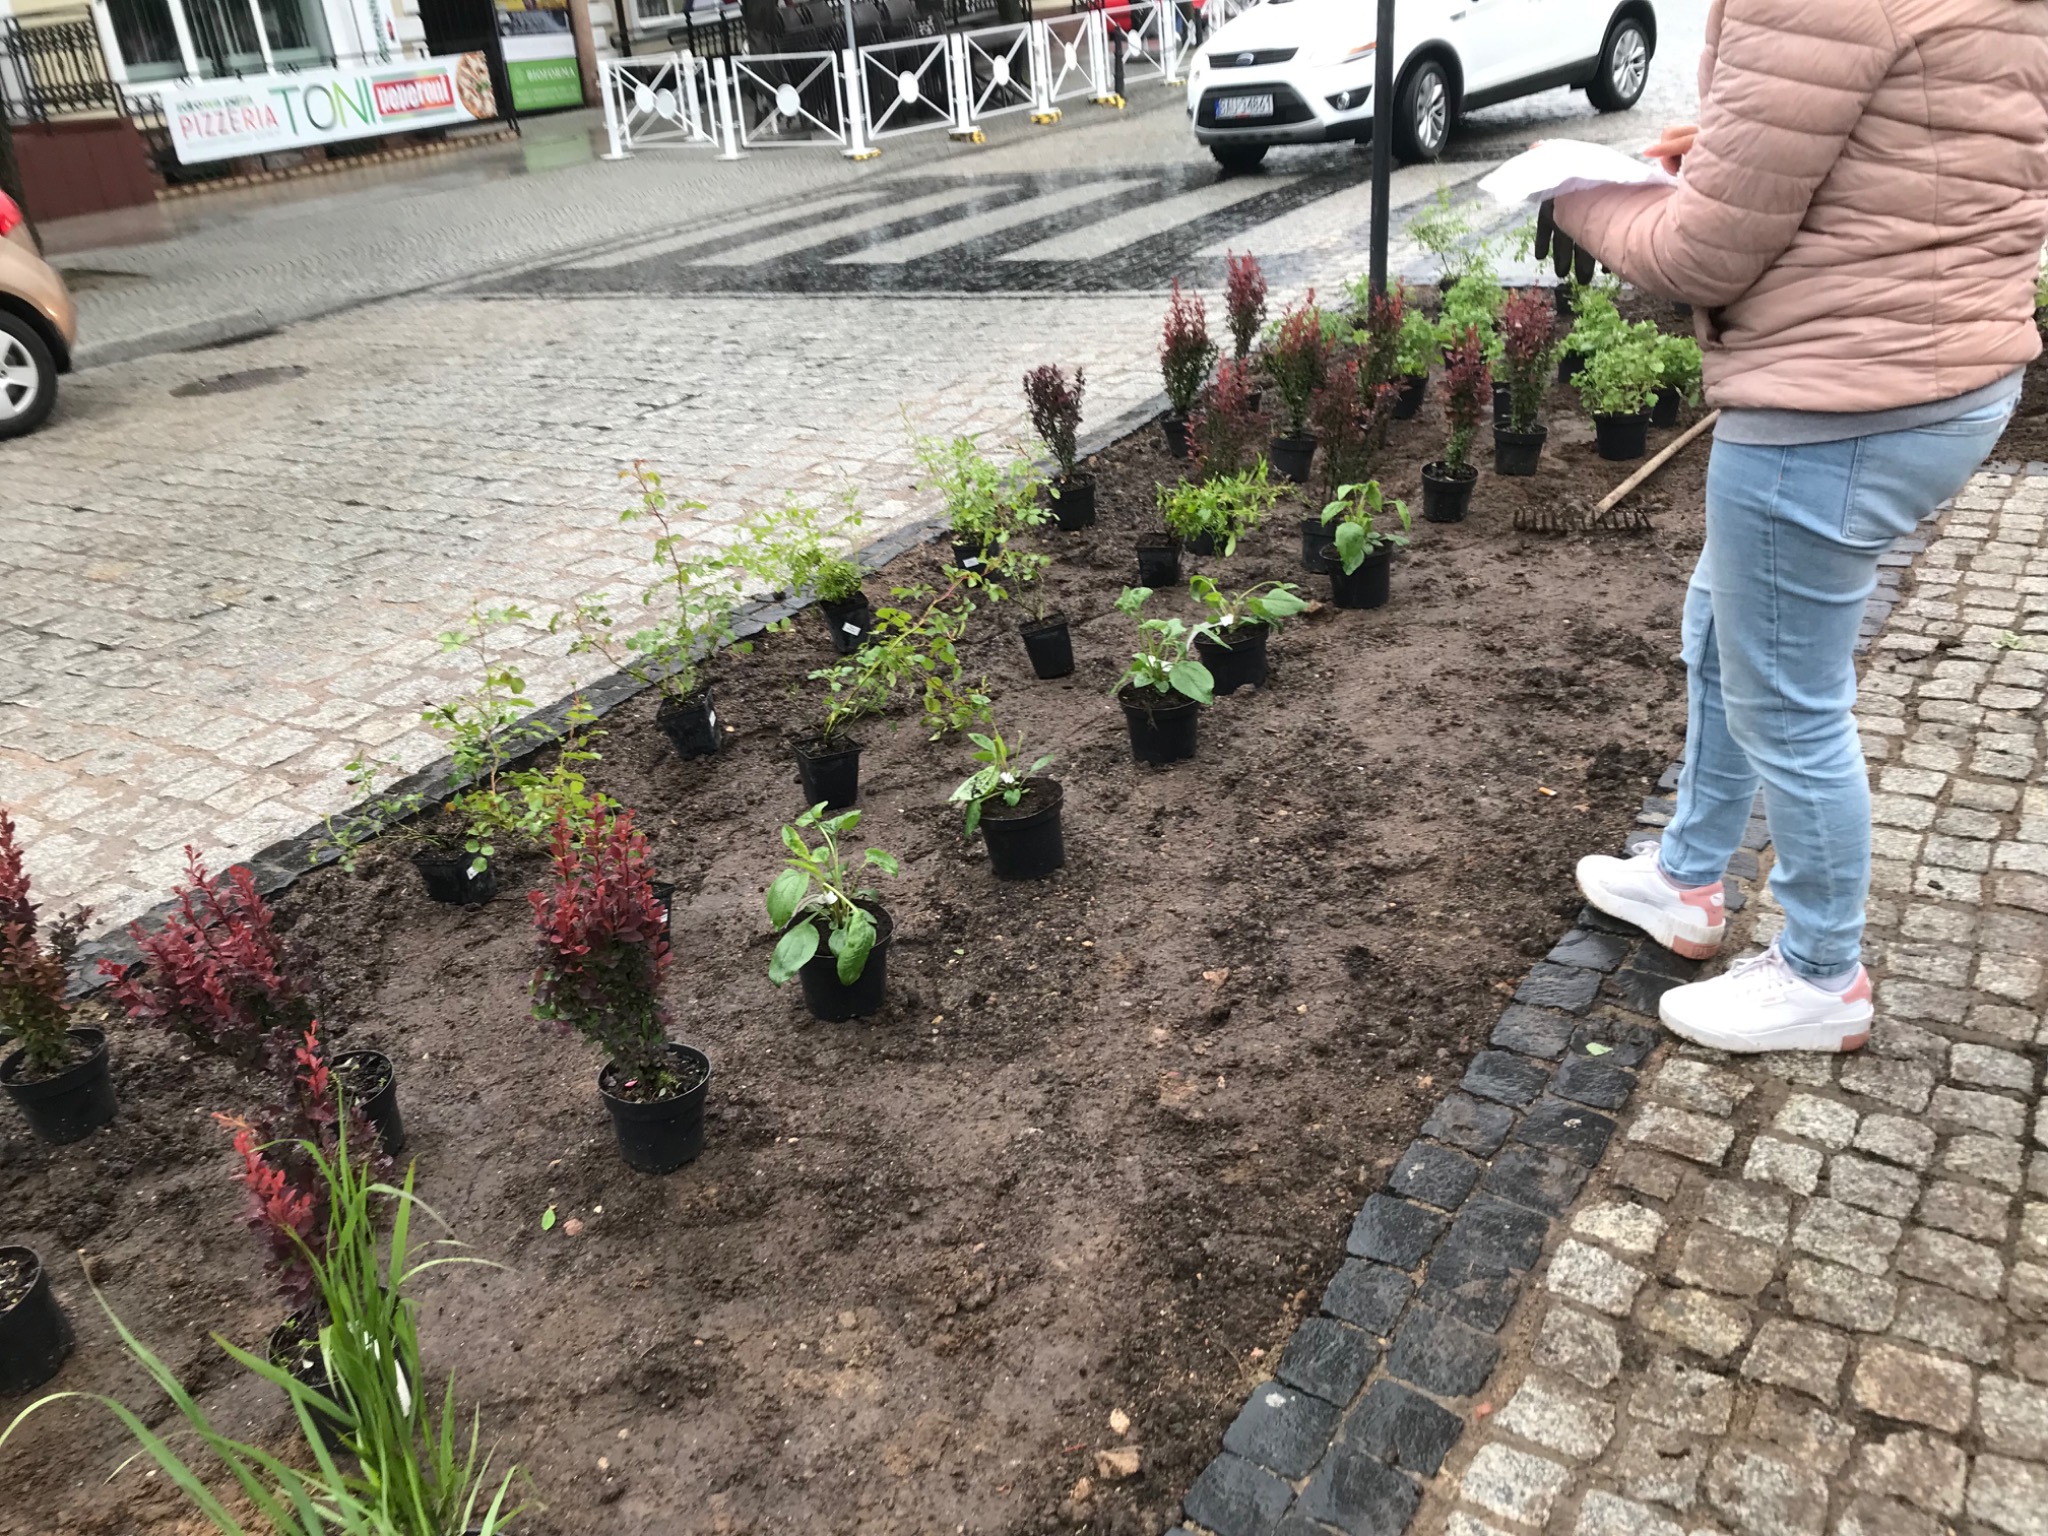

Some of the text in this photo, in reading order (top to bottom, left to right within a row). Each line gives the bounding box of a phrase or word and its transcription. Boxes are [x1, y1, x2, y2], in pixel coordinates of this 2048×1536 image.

[178, 104, 280, 139] PIZZERIA
[268, 77, 377, 136] TONI
[377, 74, 451, 114] peperoni
